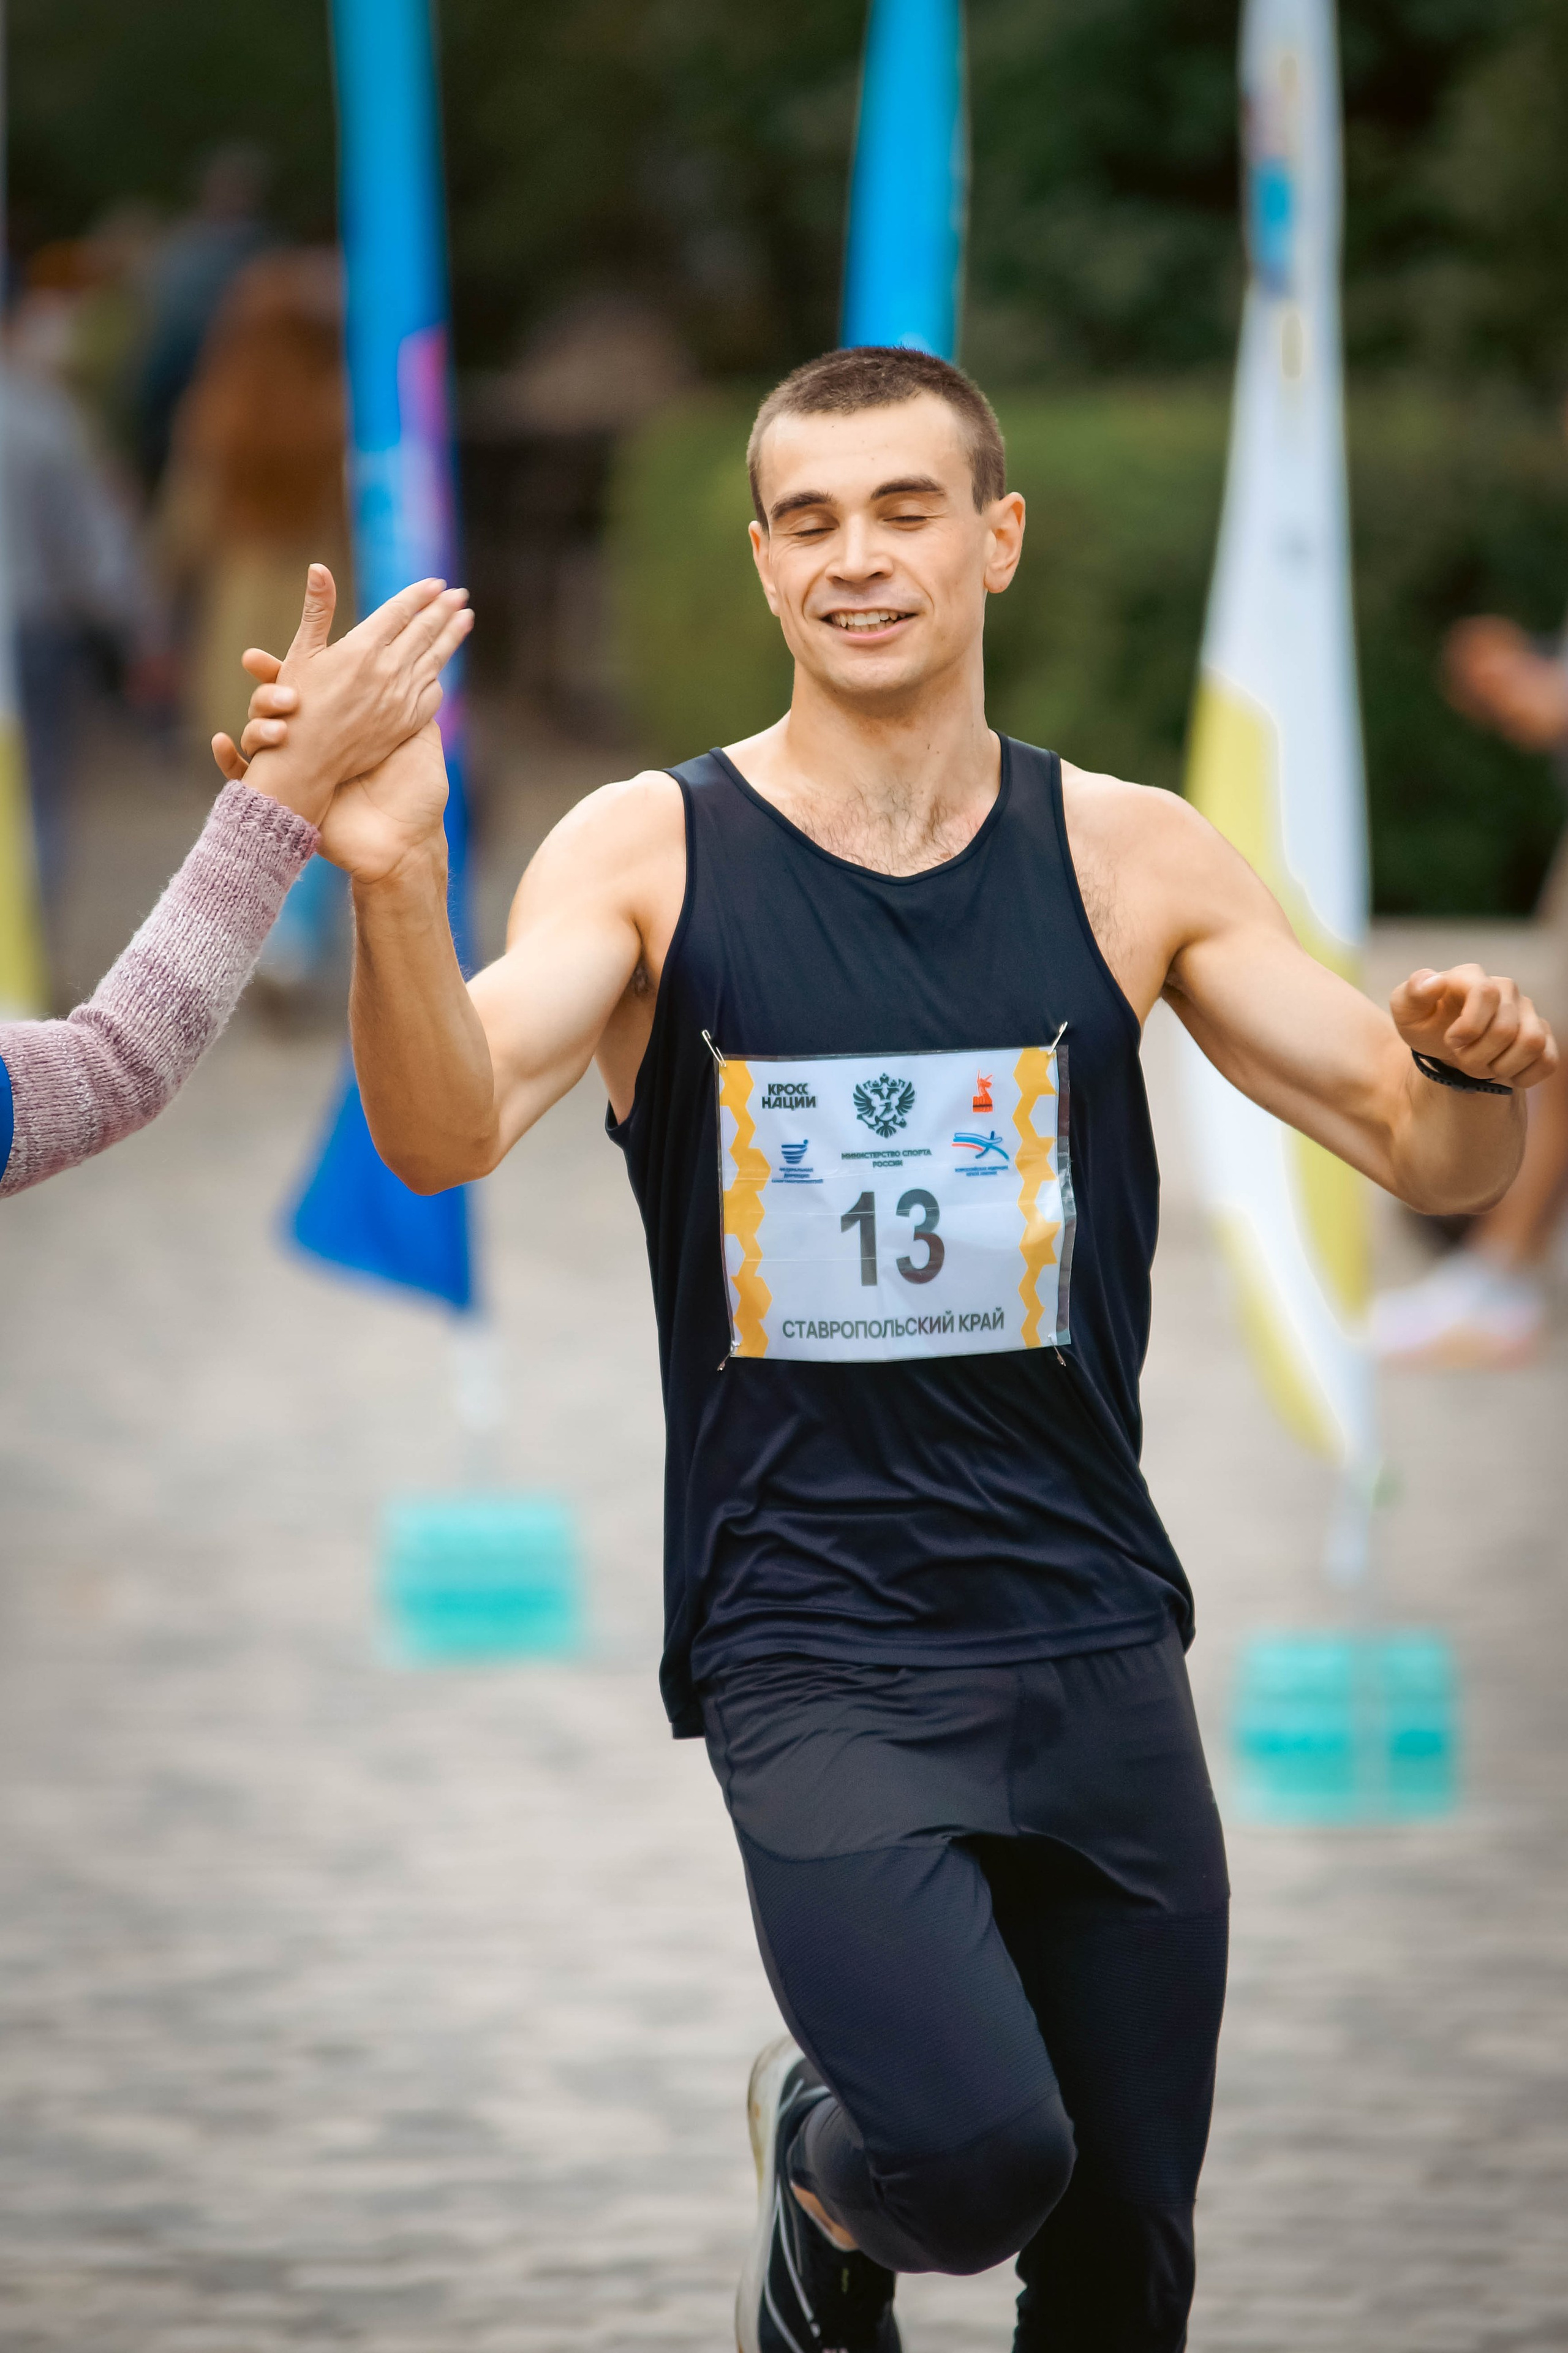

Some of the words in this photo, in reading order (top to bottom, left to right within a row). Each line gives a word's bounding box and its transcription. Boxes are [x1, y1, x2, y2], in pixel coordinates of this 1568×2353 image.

[767, 1083, 809, 1096] КРОСС
[761, 1095, 816, 1111] НАЦИИ
[902, 1149, 932, 1157] СПОРТА
[872, 1160, 903, 1168] РОССИИ
[840, 1188, 945, 1287] 13
[782, 1310, 954, 1340] СТАВРОПОЛЬСКИЙ
[959, 1307, 1005, 1332] КРАЙ
